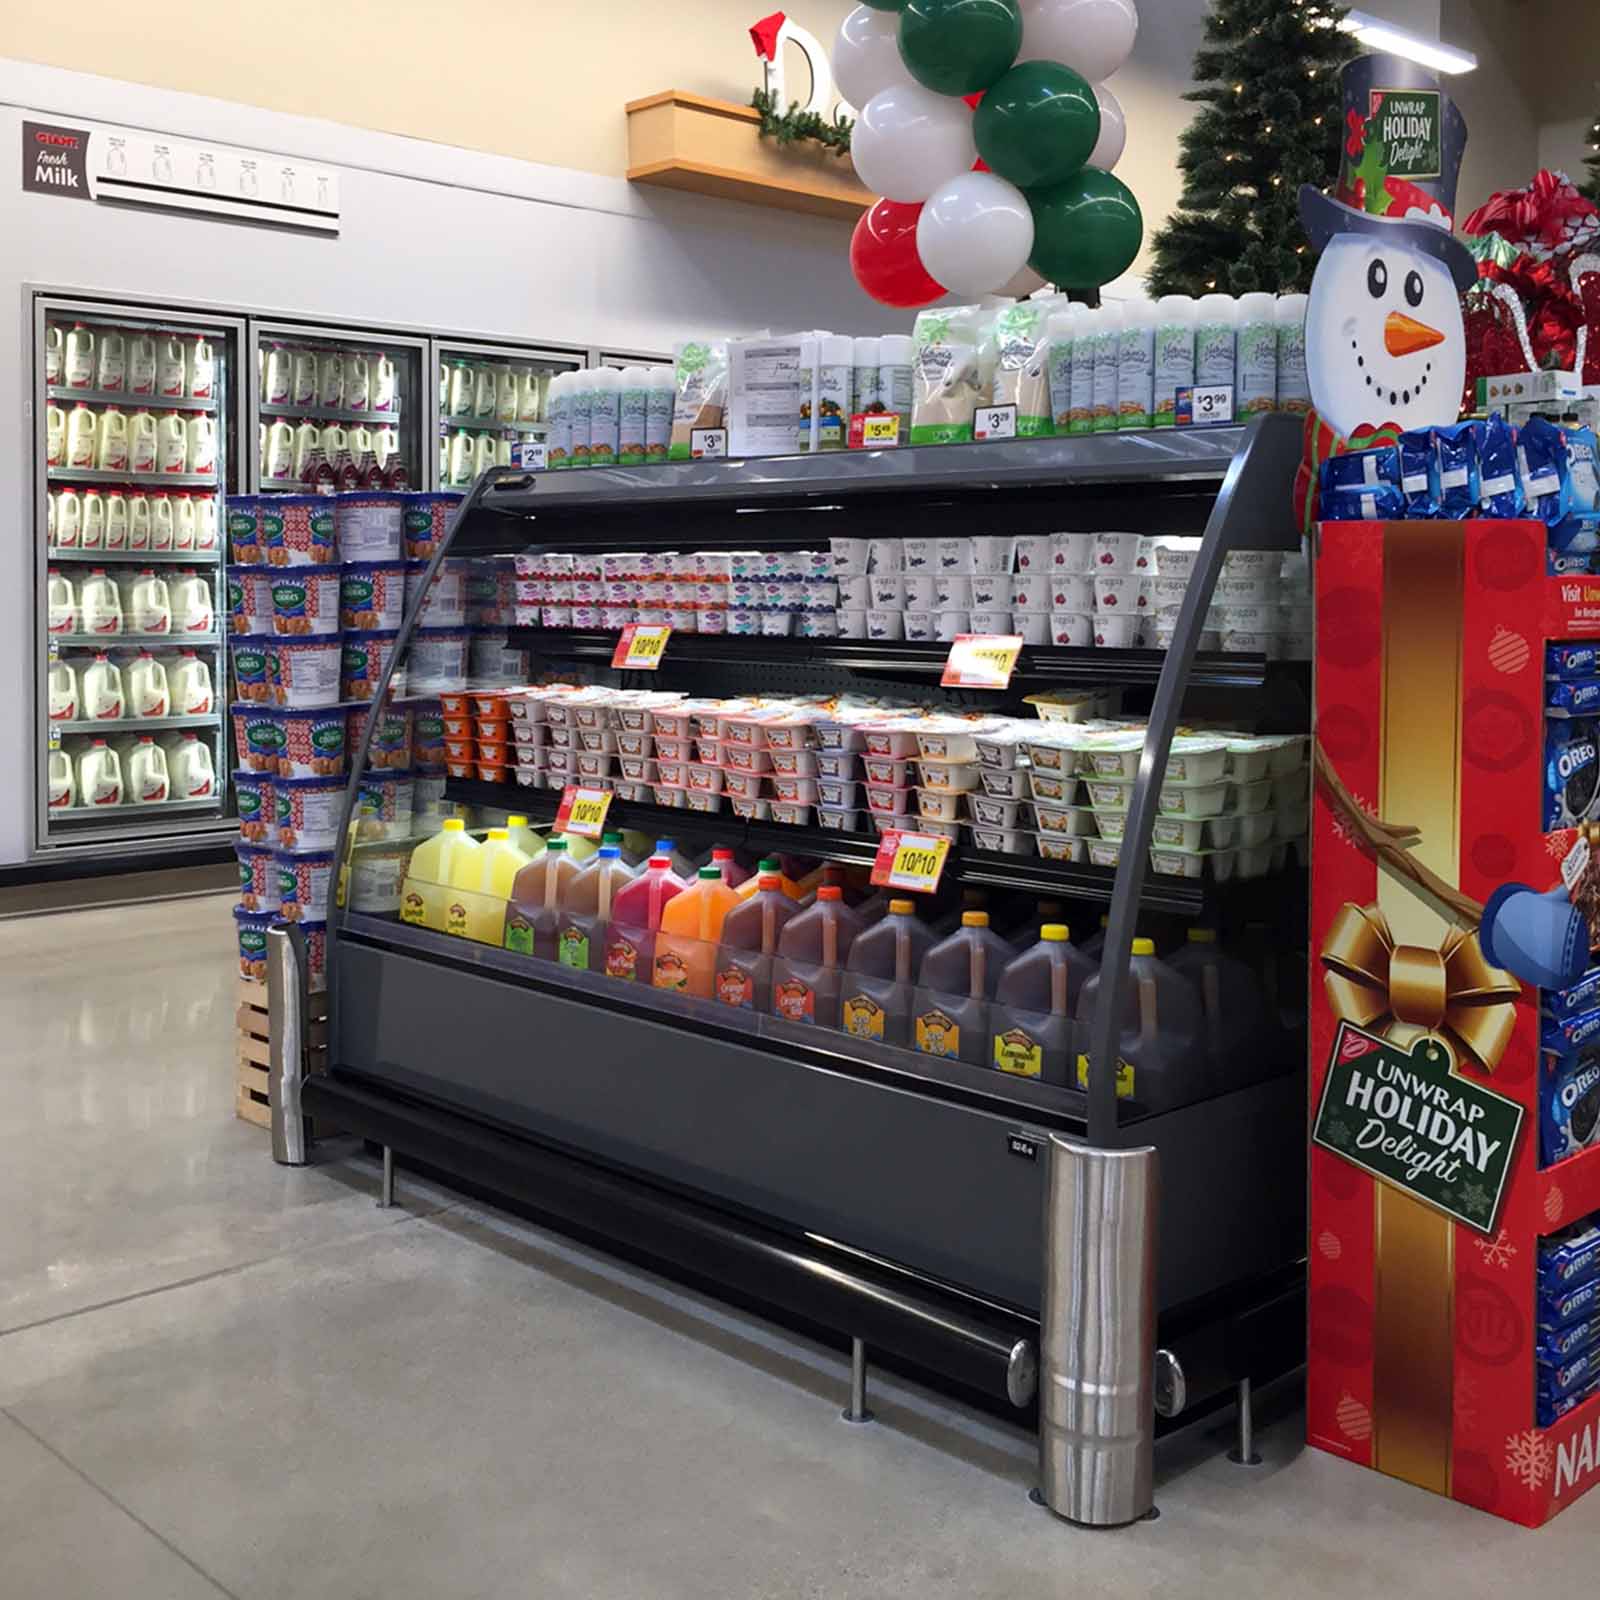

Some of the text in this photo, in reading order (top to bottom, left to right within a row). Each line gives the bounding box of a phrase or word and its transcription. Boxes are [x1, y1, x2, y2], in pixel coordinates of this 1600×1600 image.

[1389, 101, 1425, 114] UNWRAP
[1383, 116, 1432, 142] HOLIDAY
[36, 149, 68, 165] Fresh
[1389, 140, 1425, 170] Delight
[35, 164, 79, 188] Milk
[1561, 584, 1582, 602] Visit
[1558, 743, 1596, 779] OREO
[1377, 1059, 1485, 1123] UNWRAP
[1561, 1066, 1600, 1108] OREO
[1345, 1070, 1500, 1173] HOLIDAY
[1355, 1118, 1463, 1183] Delight
